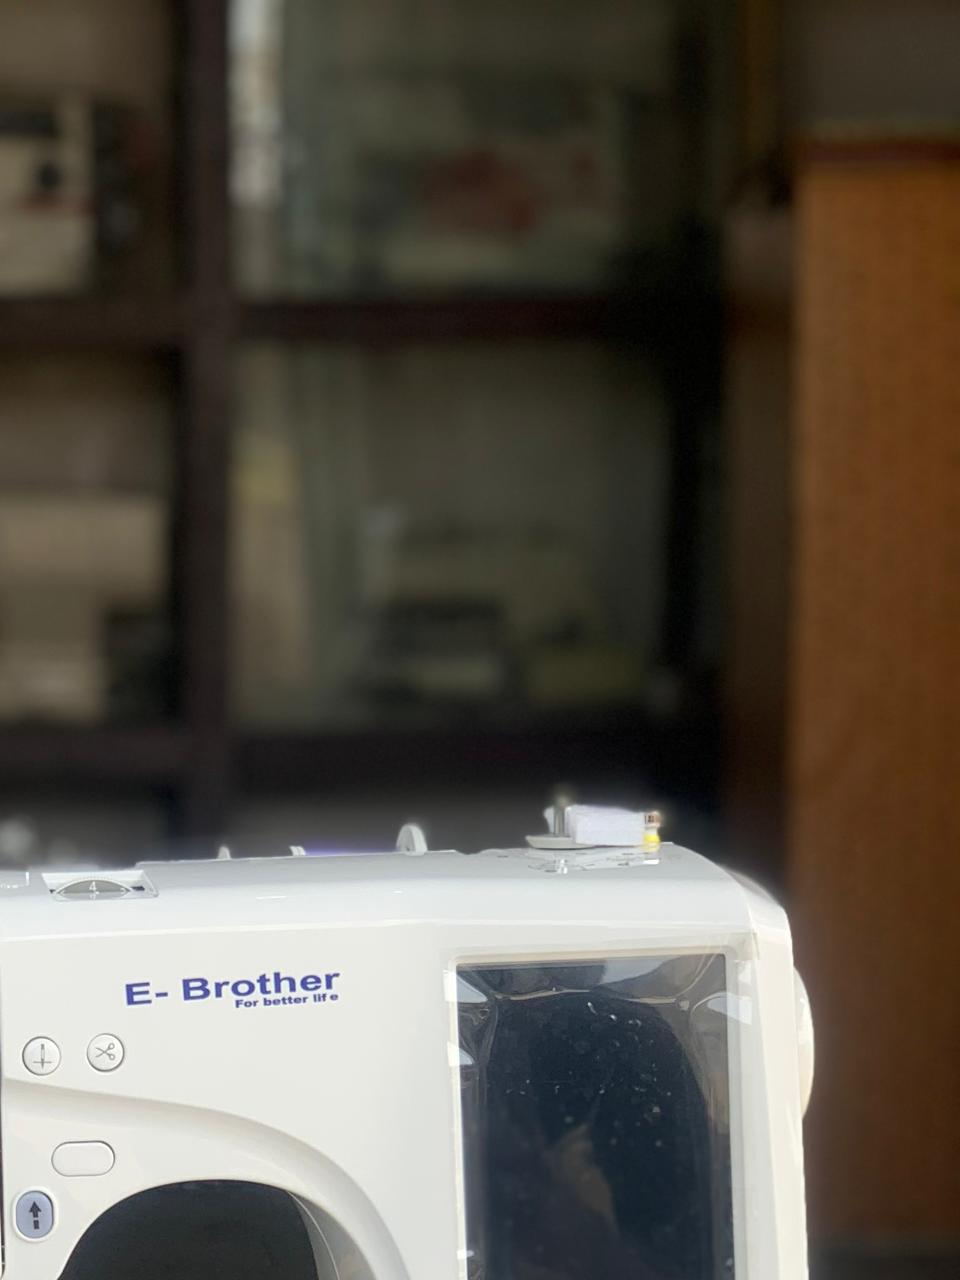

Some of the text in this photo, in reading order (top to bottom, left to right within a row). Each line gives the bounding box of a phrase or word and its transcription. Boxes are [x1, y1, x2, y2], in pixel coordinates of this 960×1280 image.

[125, 971, 340, 1006] E- Brother
[235, 999, 259, 1009] For
[263, 996, 308, 1007] better
